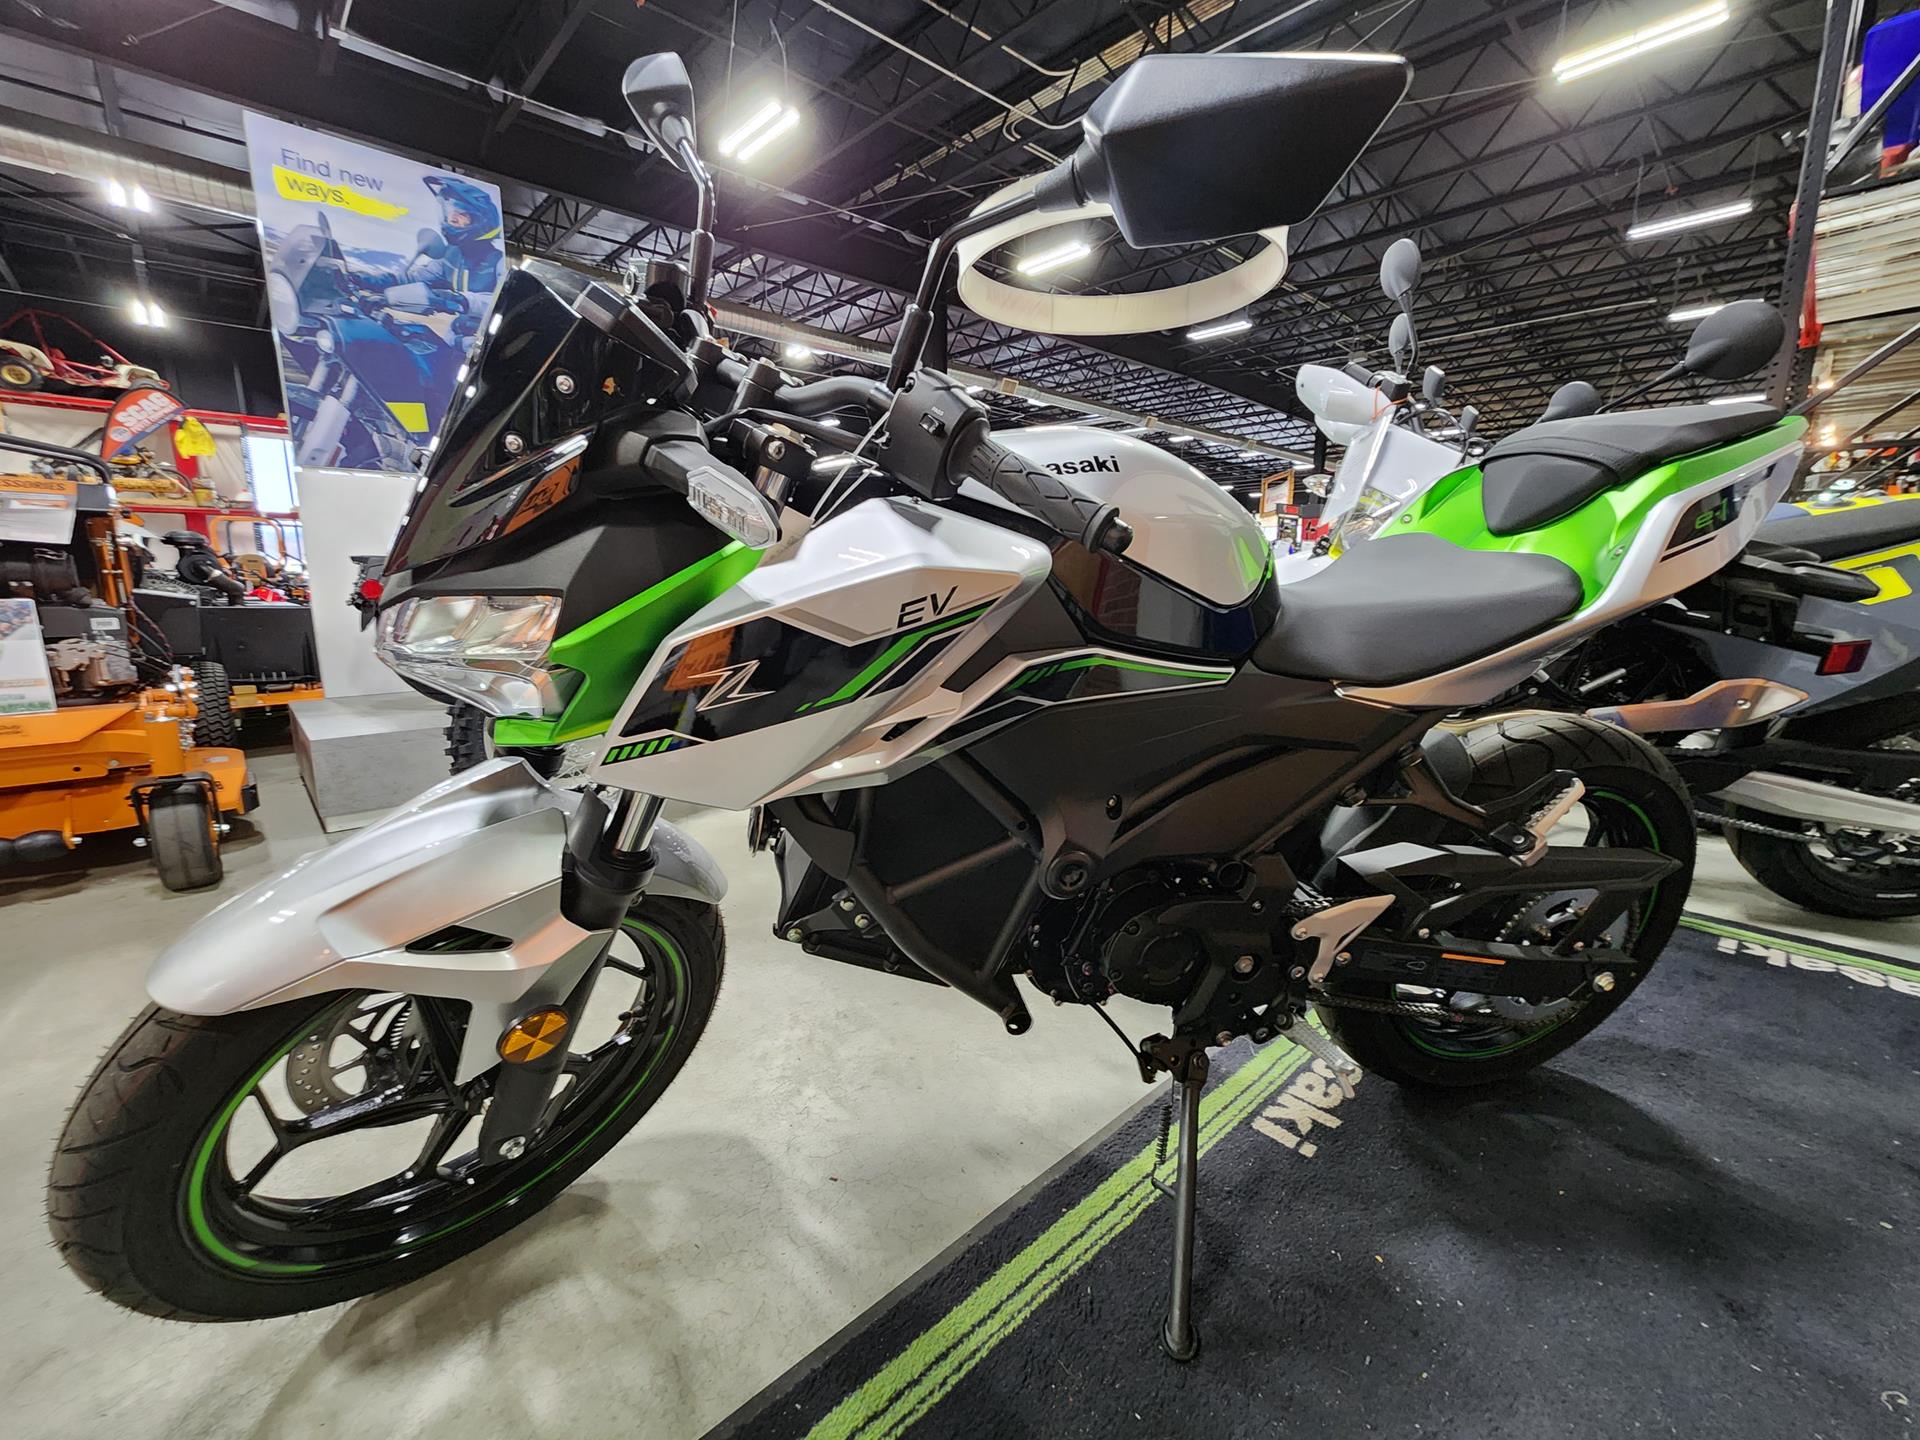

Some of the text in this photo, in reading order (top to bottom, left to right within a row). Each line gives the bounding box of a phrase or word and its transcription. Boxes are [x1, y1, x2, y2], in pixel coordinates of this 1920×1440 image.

[280, 147, 384, 192] Find new
[285, 175, 351, 205] ways.
[116, 391, 172, 426] SCAG
[1043, 455, 1121, 475] asaki
[896, 584, 960, 629] EV
